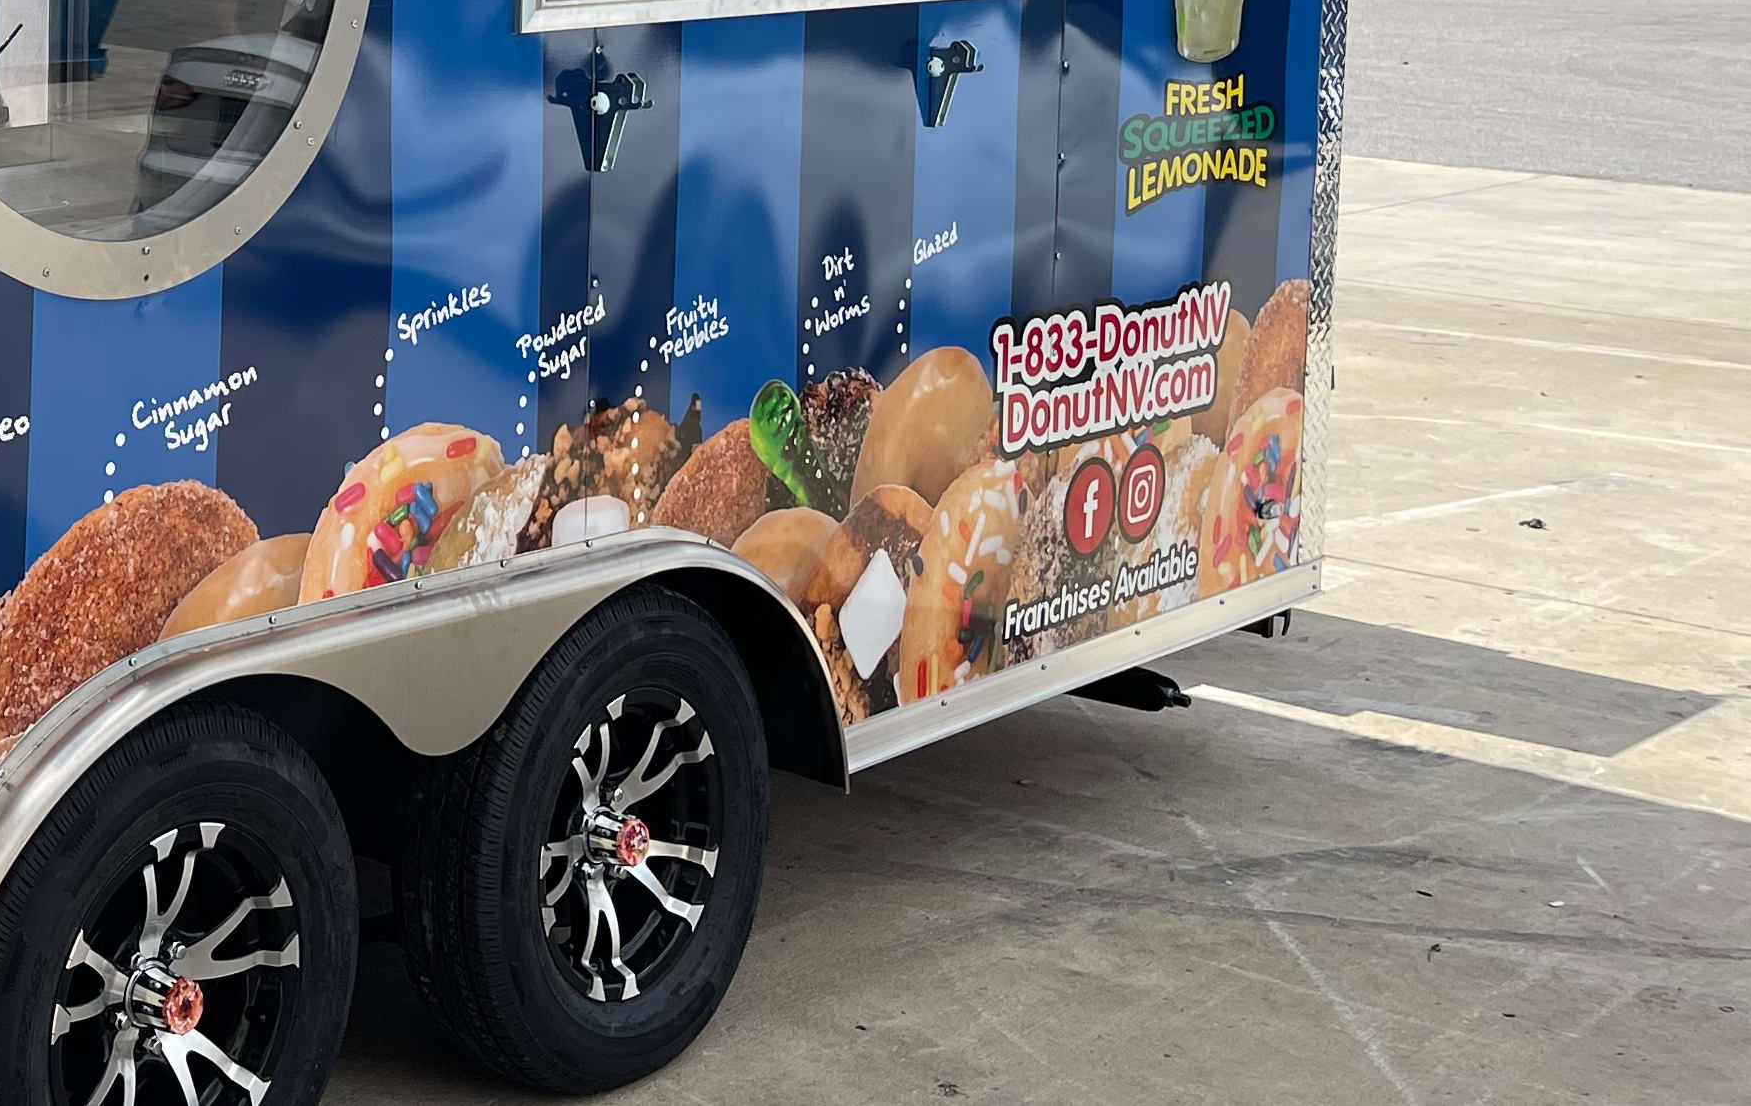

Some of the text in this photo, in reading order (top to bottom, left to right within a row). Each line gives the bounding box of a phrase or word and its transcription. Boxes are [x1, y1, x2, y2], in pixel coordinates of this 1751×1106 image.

[1166, 74, 1244, 117] FRESH
[1123, 105, 1275, 160] SQUEEZED
[1127, 148, 1268, 210] LEMONADE
[822, 246, 855, 281] Dirt
[913, 222, 958, 265] Glazed
[397, 283, 492, 341] Sprinkles
[516, 295, 606, 358] Powdered
[665, 294, 719, 335] Fruity
[814, 295, 871, 337] Worms
[998, 291, 1227, 383] 1-833-DonutNV
[538, 336, 588, 380] Sugar
[131, 365, 258, 429] Cinnamon
[1006, 360, 1212, 443] DonutNV.com
[163, 403, 232, 452] Sugar
[1004, 544, 1198, 639] Franchises Available
